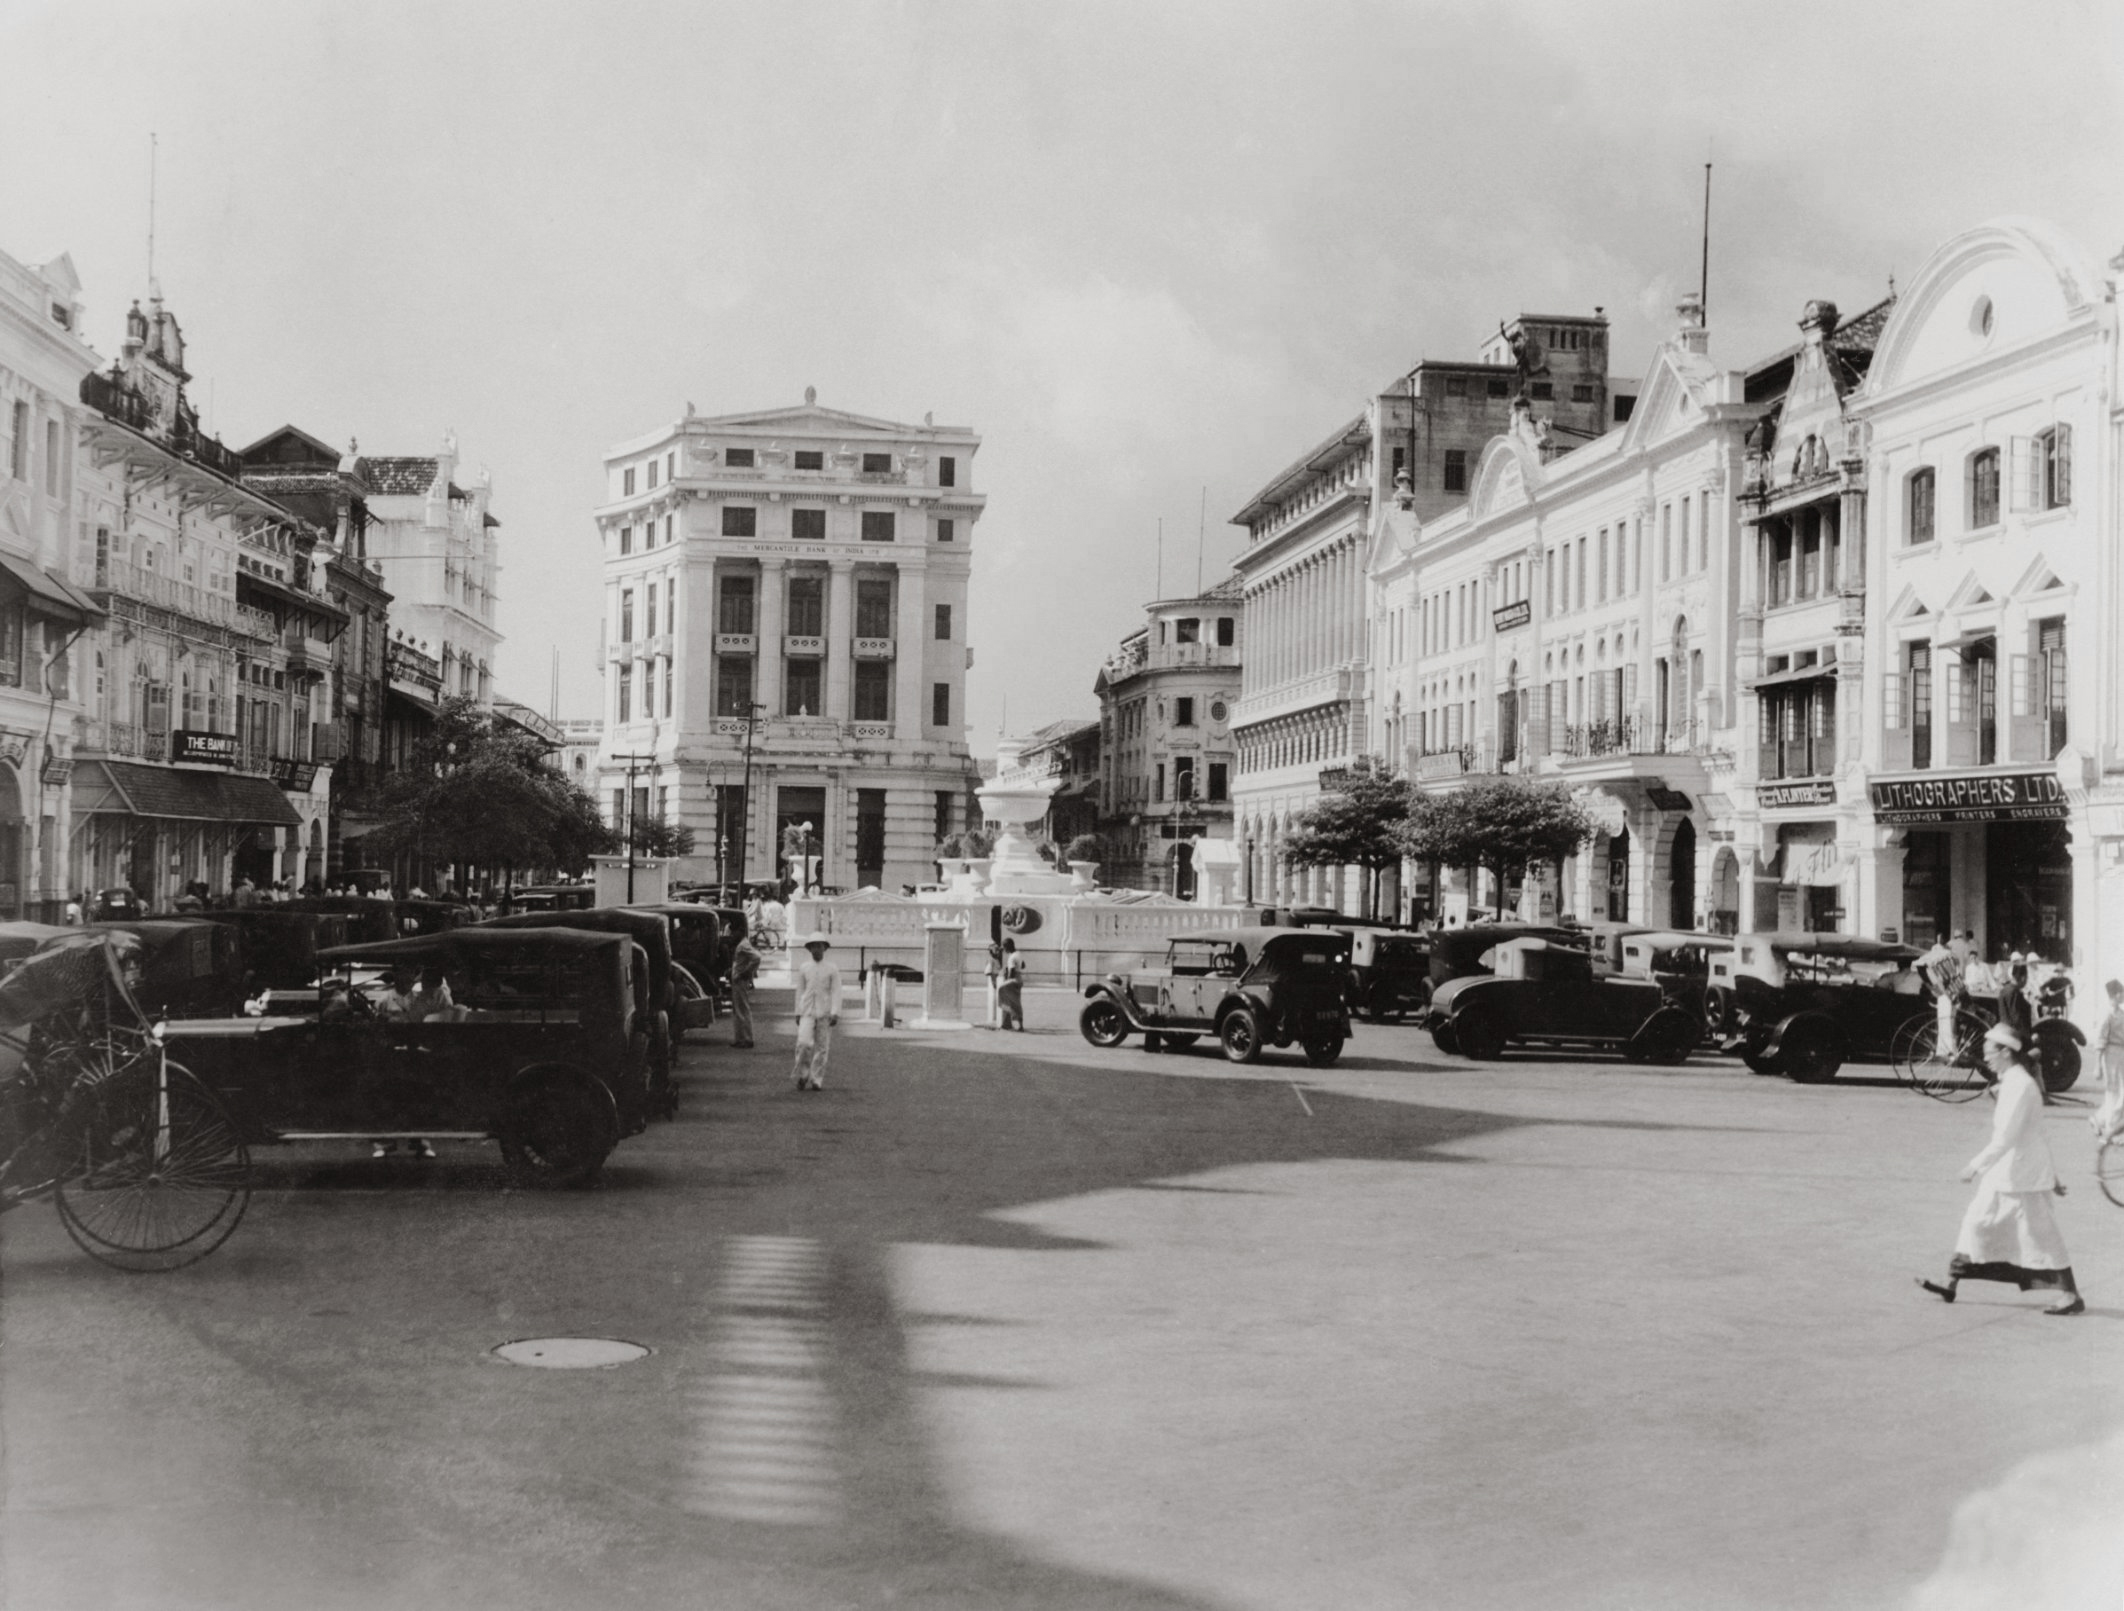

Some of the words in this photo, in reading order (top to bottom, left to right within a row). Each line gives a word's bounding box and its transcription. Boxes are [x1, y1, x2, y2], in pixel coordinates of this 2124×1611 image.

[754, 544, 799, 552] MERCANTILE
[187, 736, 206, 750] THE
[1877, 777, 2016, 808] LITHOGRAPHERS
[1881, 812, 1942, 823] LITHOGRAPHERS
[1955, 810, 1996, 820] PRINTERS
[2010, 807, 2062, 819] ENGRAVERS
